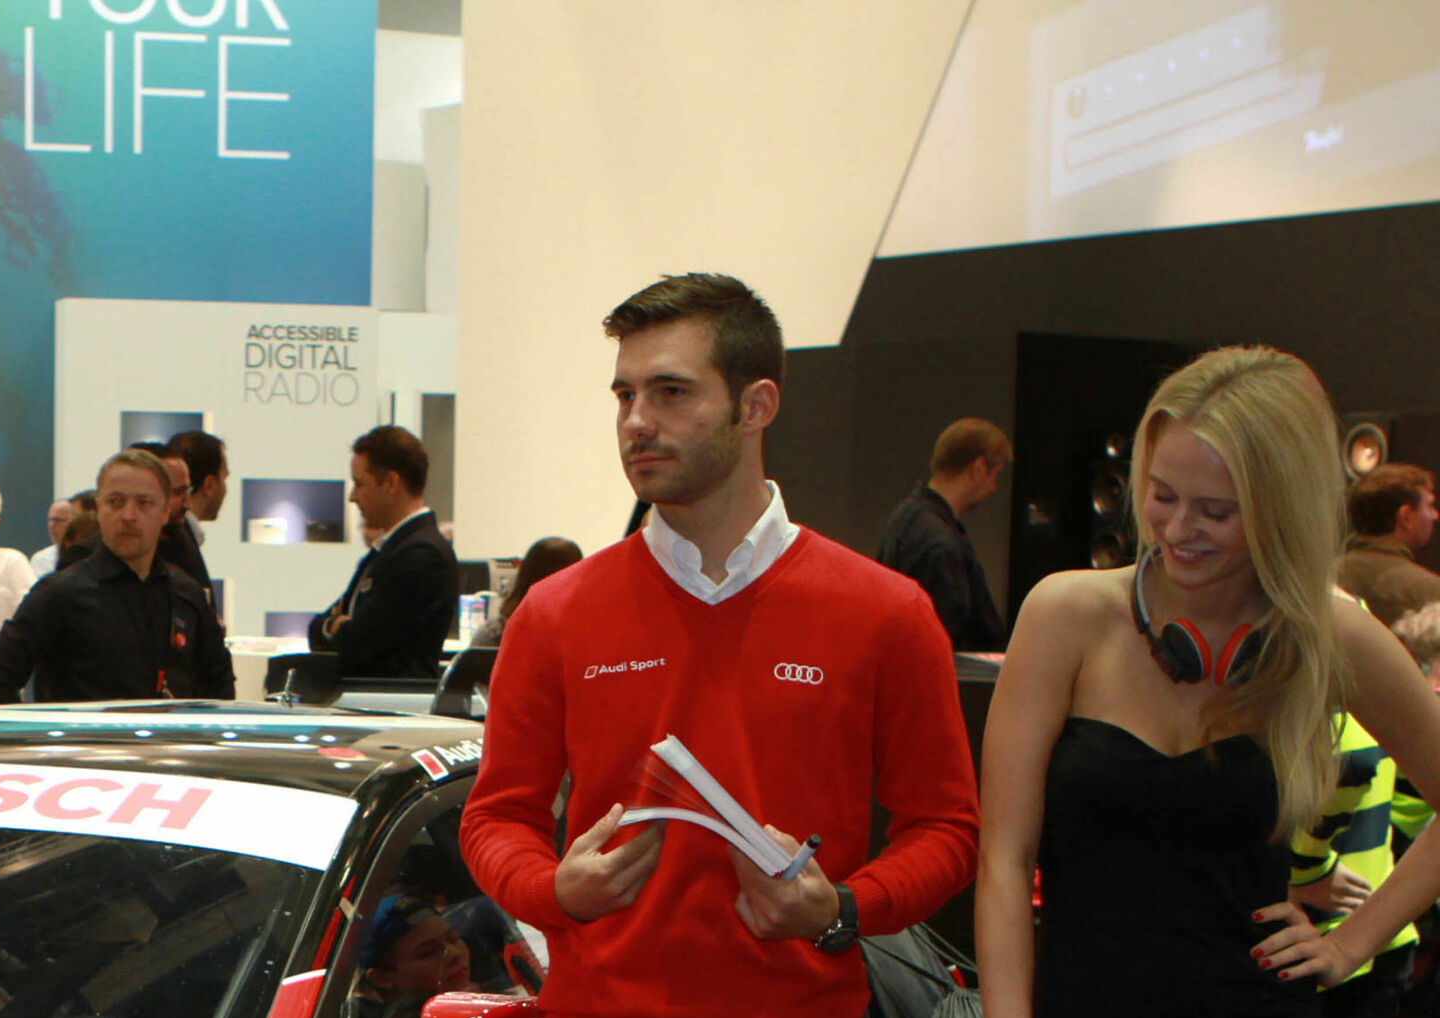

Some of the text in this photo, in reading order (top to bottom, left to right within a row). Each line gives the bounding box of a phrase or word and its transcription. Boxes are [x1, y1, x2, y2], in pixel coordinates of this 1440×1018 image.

[24, 26, 292, 160] LIFE
[246, 323, 360, 342] ACCESSIBLE
[244, 342, 359, 370] DIGITAL
[243, 371, 360, 406] RADIO
[598, 657, 667, 674] Audi Sport
